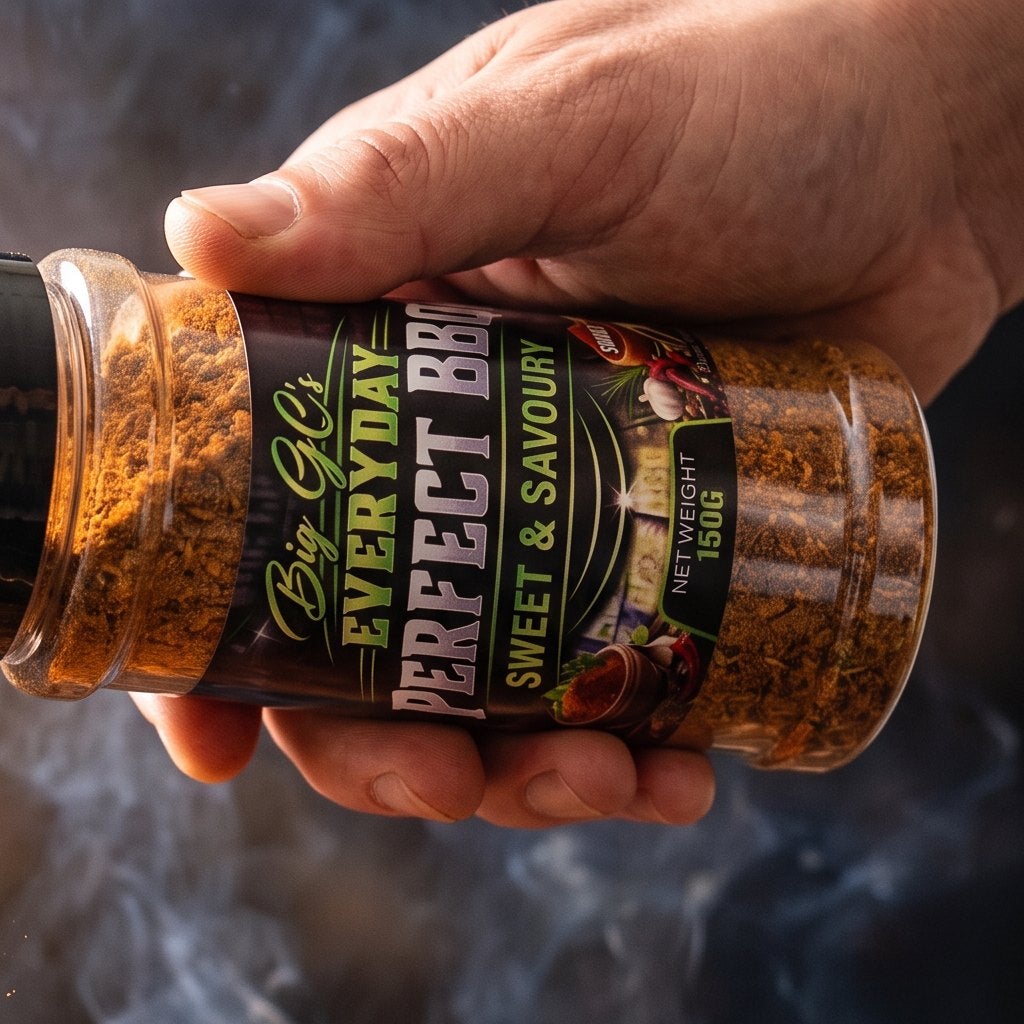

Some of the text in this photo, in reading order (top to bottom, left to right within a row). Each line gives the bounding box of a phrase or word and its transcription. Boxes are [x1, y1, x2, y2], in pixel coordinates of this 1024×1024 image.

[265, 516, 339, 642] Big
[342, 344, 399, 649] EVERYDAY
[392, 416, 490, 720] PERFECT
[506, 339, 558, 689] SWEET & SAVOURY
[671, 451, 696, 594] NET WEIGHT
[696, 490, 724, 562] 150G
